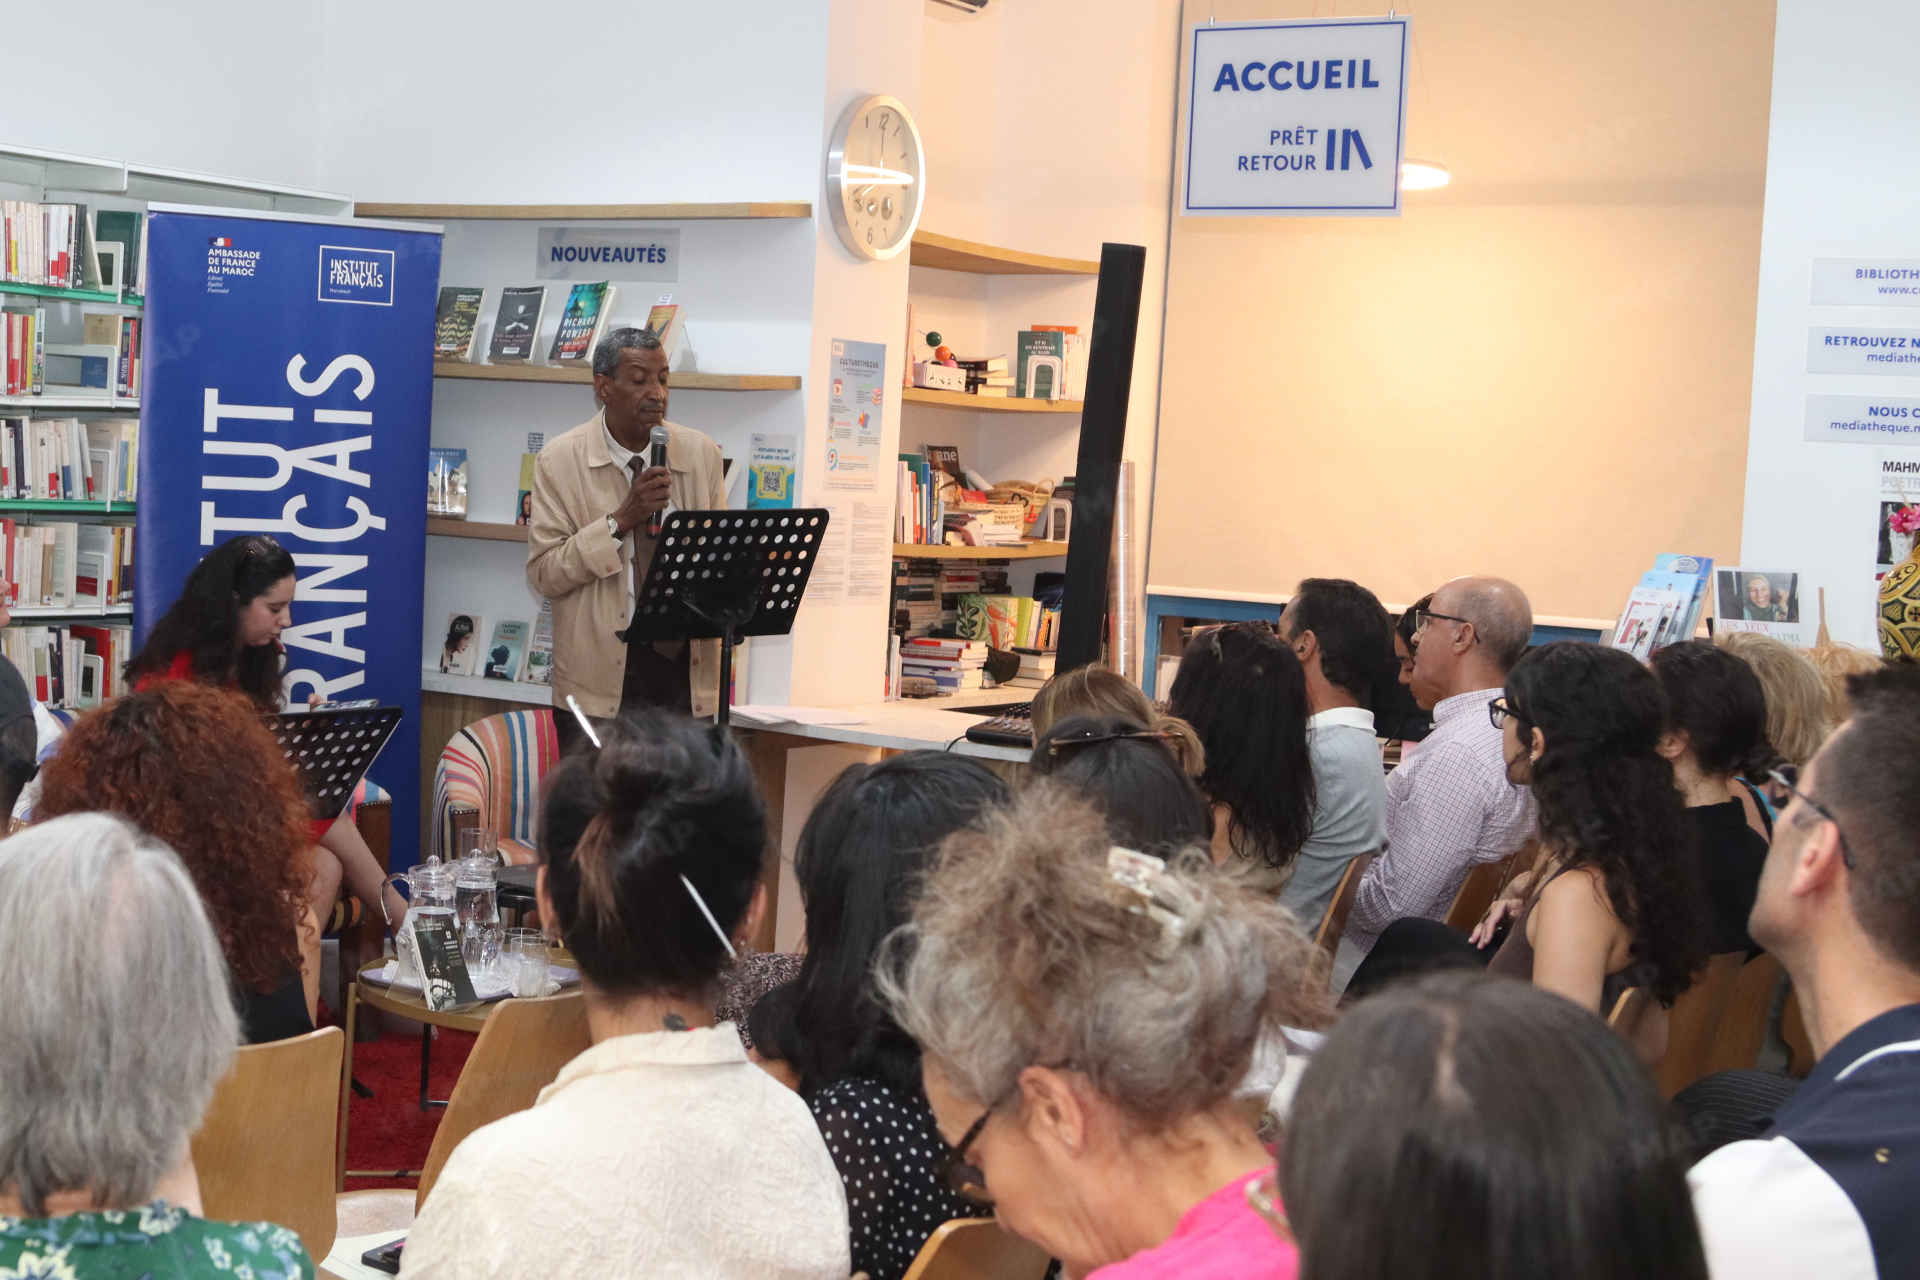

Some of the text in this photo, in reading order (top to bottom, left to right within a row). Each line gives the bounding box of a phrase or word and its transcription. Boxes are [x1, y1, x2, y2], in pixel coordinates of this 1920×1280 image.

[1213, 59, 1379, 92] ACCUEIL
[879, 112, 889, 130] 12
[1270, 125, 1318, 146] PRÊT
[1237, 154, 1317, 171] RETOUR
[867, 226, 873, 245] 6
[208, 248, 261, 260] AMBASSADE
[551, 244, 667, 264] NOUVEAUTÉS
[208, 257, 256, 268] DE FRANCE
[330, 259, 379, 276] INSTITUT
[207, 266, 254, 277] AU MAROC
[1855, 268, 1920, 279] BIBLIOTH
[1878, 286, 1920, 295] www.c
[563, 315, 596, 327] RICHARD
[560, 328, 591, 339] POWERS
[1824, 335, 1907, 348] RETROUVEZ
[1868, 406, 1908, 418] NOUS
[280, 353, 387, 714] RANÇAIS
[1720, 620, 1770, 632] LES YEUX
